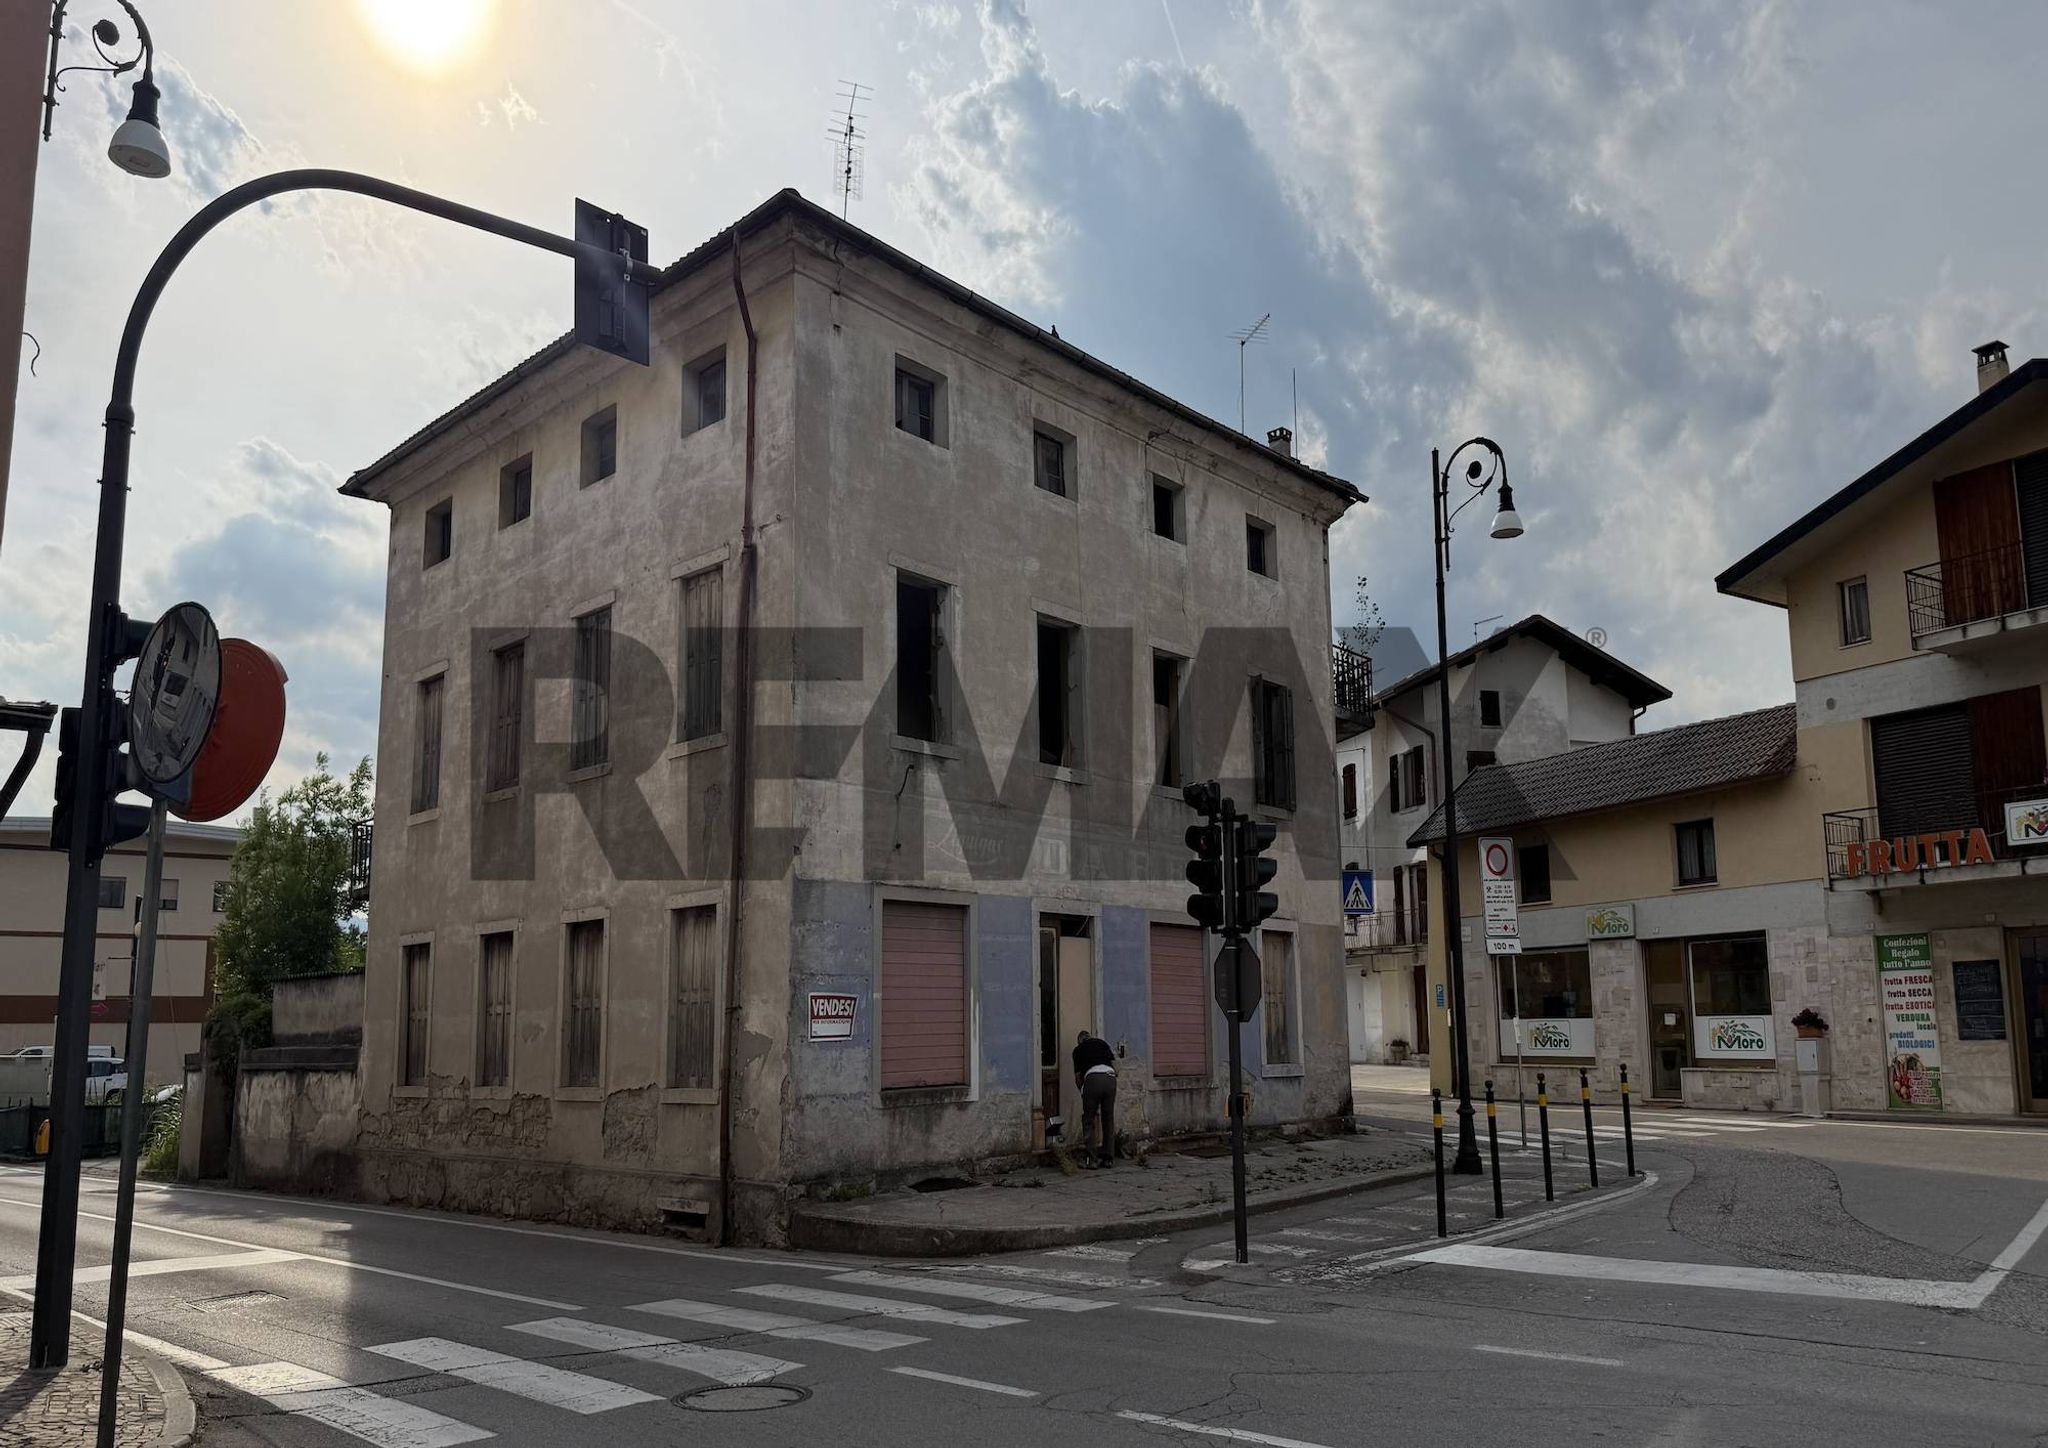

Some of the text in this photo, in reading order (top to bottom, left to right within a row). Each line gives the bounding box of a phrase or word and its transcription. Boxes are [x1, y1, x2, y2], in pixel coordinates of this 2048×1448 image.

[1846, 828, 1994, 879] FRUTTA
[1592, 922, 1630, 936] Moro
[1493, 942, 1507, 950] 100
[1883, 936, 1926, 947] Confezioni
[1891, 948, 1920, 959] Regalo
[1882, 959, 1931, 968] tutto l'anno
[1884, 975, 1933, 986] frutta FRESCA
[1887, 988, 1933, 998] frutta SECCA
[812, 998, 855, 1016] VENDESI
[1896, 1013, 1931, 1022] VERDURA
[1916, 1022, 1937, 1030] locale
[1889, 1031, 1914, 1039] prodotti
[1533, 1036, 1569, 1048] Moro
[1717, 1035, 1764, 1049] Moro
[1897, 1040, 1935, 1049] BIOLOGICI
